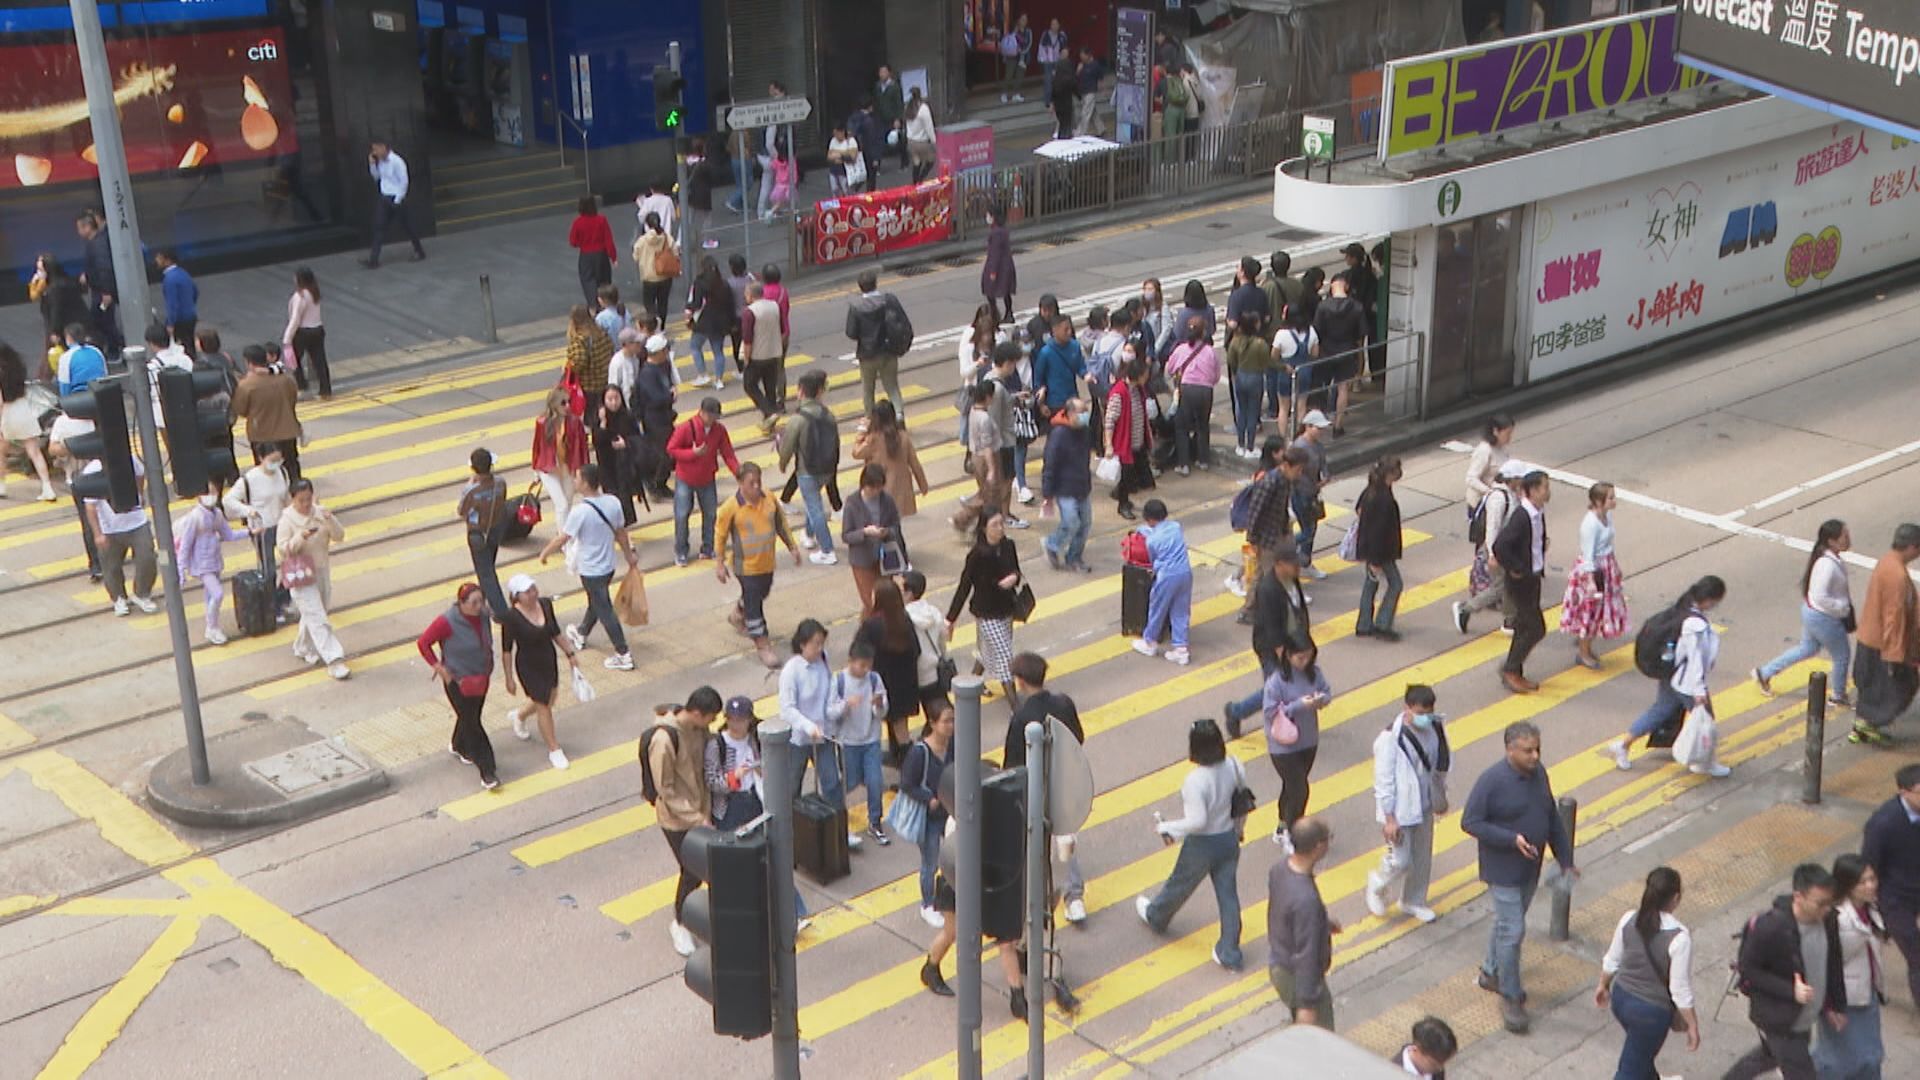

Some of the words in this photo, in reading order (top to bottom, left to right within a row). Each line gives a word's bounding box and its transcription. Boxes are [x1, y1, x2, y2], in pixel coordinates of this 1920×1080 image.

[247, 41, 278, 61] citi
[1780, 0, 1839, 56] 溫度
[1846, 10, 1920, 87] Temp
[1389, 50, 1487, 155] BE
[1491, 17, 1712, 133] PROU
[1795, 130, 1870, 187] 旅遊達人
[1645, 199, 1698, 250] 女神
[1627, 278, 1705, 331] 小鮮肉
